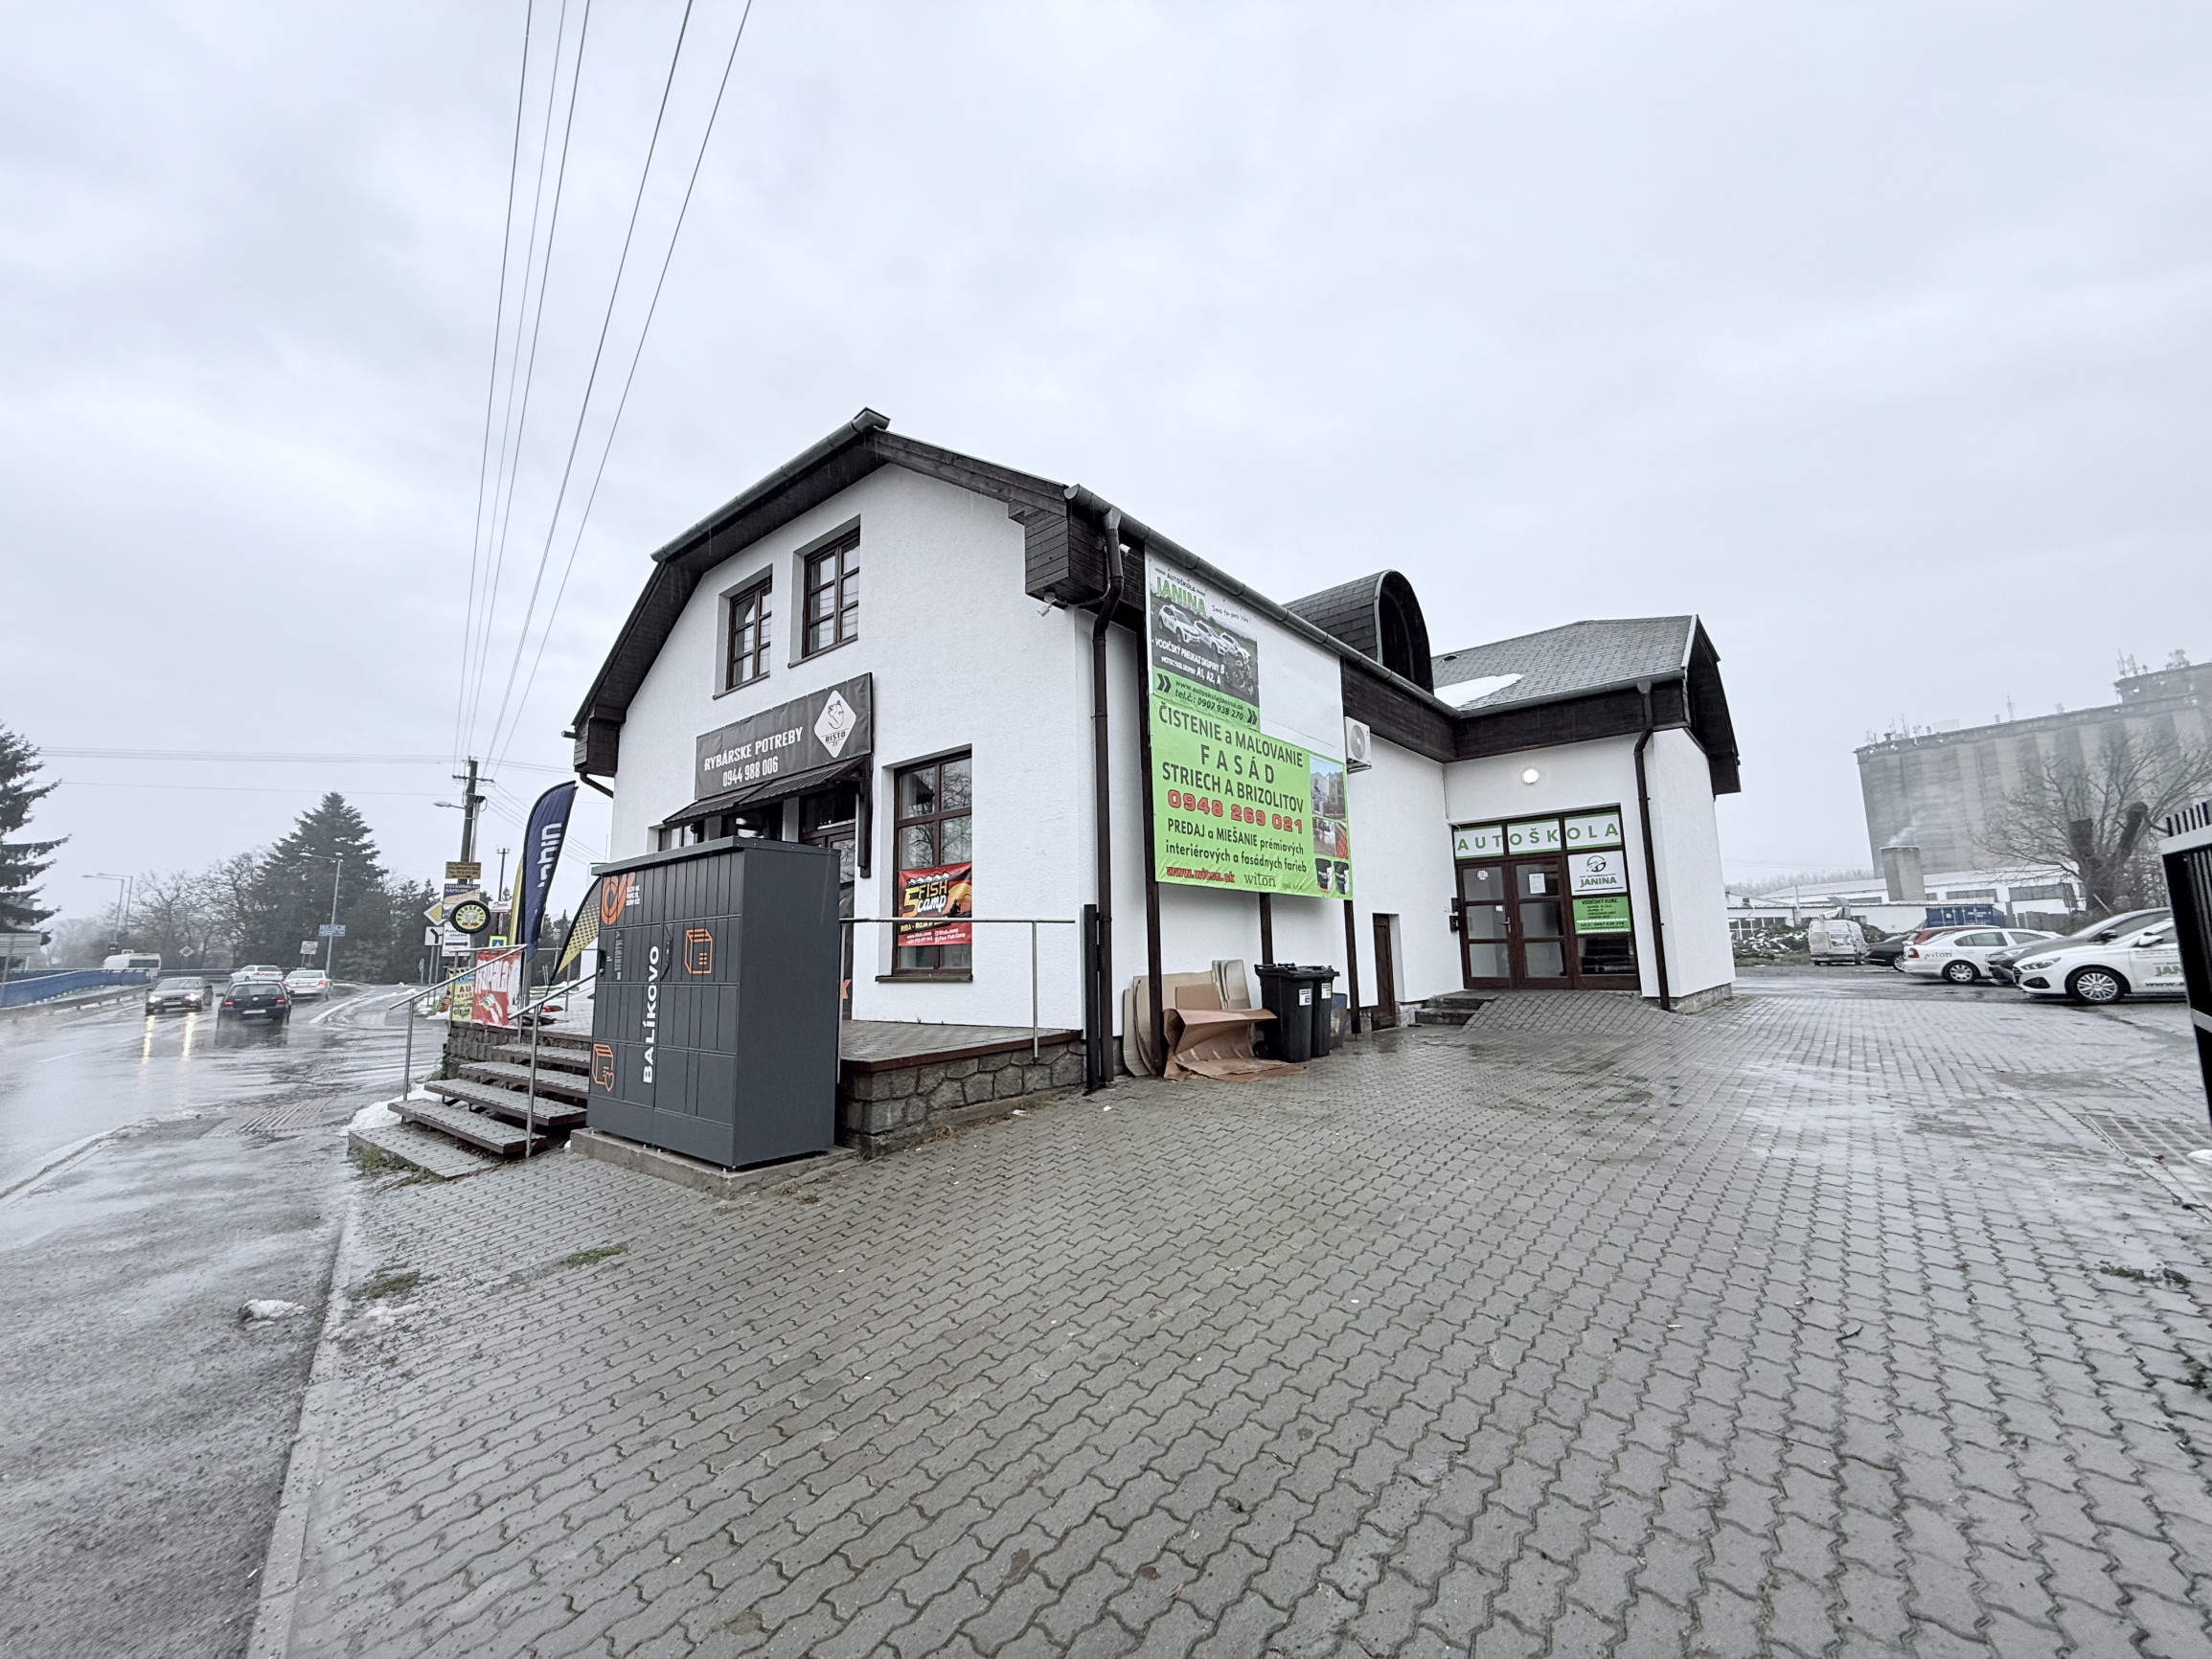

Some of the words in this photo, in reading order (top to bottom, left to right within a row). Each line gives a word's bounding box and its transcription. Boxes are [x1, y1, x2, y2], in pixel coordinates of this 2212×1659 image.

[1155, 577, 1207, 617] JANINA
[1206, 670, 1216, 684] A2,
[1216, 674, 1221, 685] A
[1220, 664, 1225, 674] B
[1175, 680, 1243, 710] www.autoskolajanina.sk
[1197, 697, 1216, 710] 0907
[1217, 704, 1230, 716] 938
[1231, 710, 1244, 720] 270
[704, 743, 752, 772] RYBÁRSKE
[755, 726, 804, 755] POTREBY
[825, 731, 846, 743] RISTO
[1159, 701, 1222, 742] ČISTENIE
[1225, 730, 1232, 744] a
[1235, 731, 1304, 768] MAĽOVANIE
[722, 767, 743, 788] 0944
[744, 761, 760, 782] 988
[763, 756, 779, 777] 006
[1162, 761, 1221, 793] STRIECH
[1224, 781, 1235, 797] A
[1237, 782, 1304, 813] BRIZOLITOV
[1167, 789, 1223, 818] 0948
[1230, 804, 1266, 827] 269
[1272, 813, 1303, 834] 021
[1167, 818, 1205, 839] PREDAJ
[1208, 829, 1214, 840] a
[1216, 826, 1258, 848] MIEŠANIE
[1260, 838, 1304, 856] prémiových
[1457, 823, 1619, 852] AUTOŠKOLA
[1166, 839, 1231, 863] interiérových
[1233, 852, 1239, 863] a
[1241, 852, 1283, 872] fasádnych
[1284, 857, 1307, 873] farieb
[1166, 867, 1236, 883] www.witon.sk
[1243, 872, 1277, 888] witon
[1580, 876, 1617, 888] JANINA
[901, 886, 920, 918] 5
[919, 880, 948, 898] FISH
[917, 895, 946, 913] camp
[643, 945, 660, 1083] BALÍKOVO
